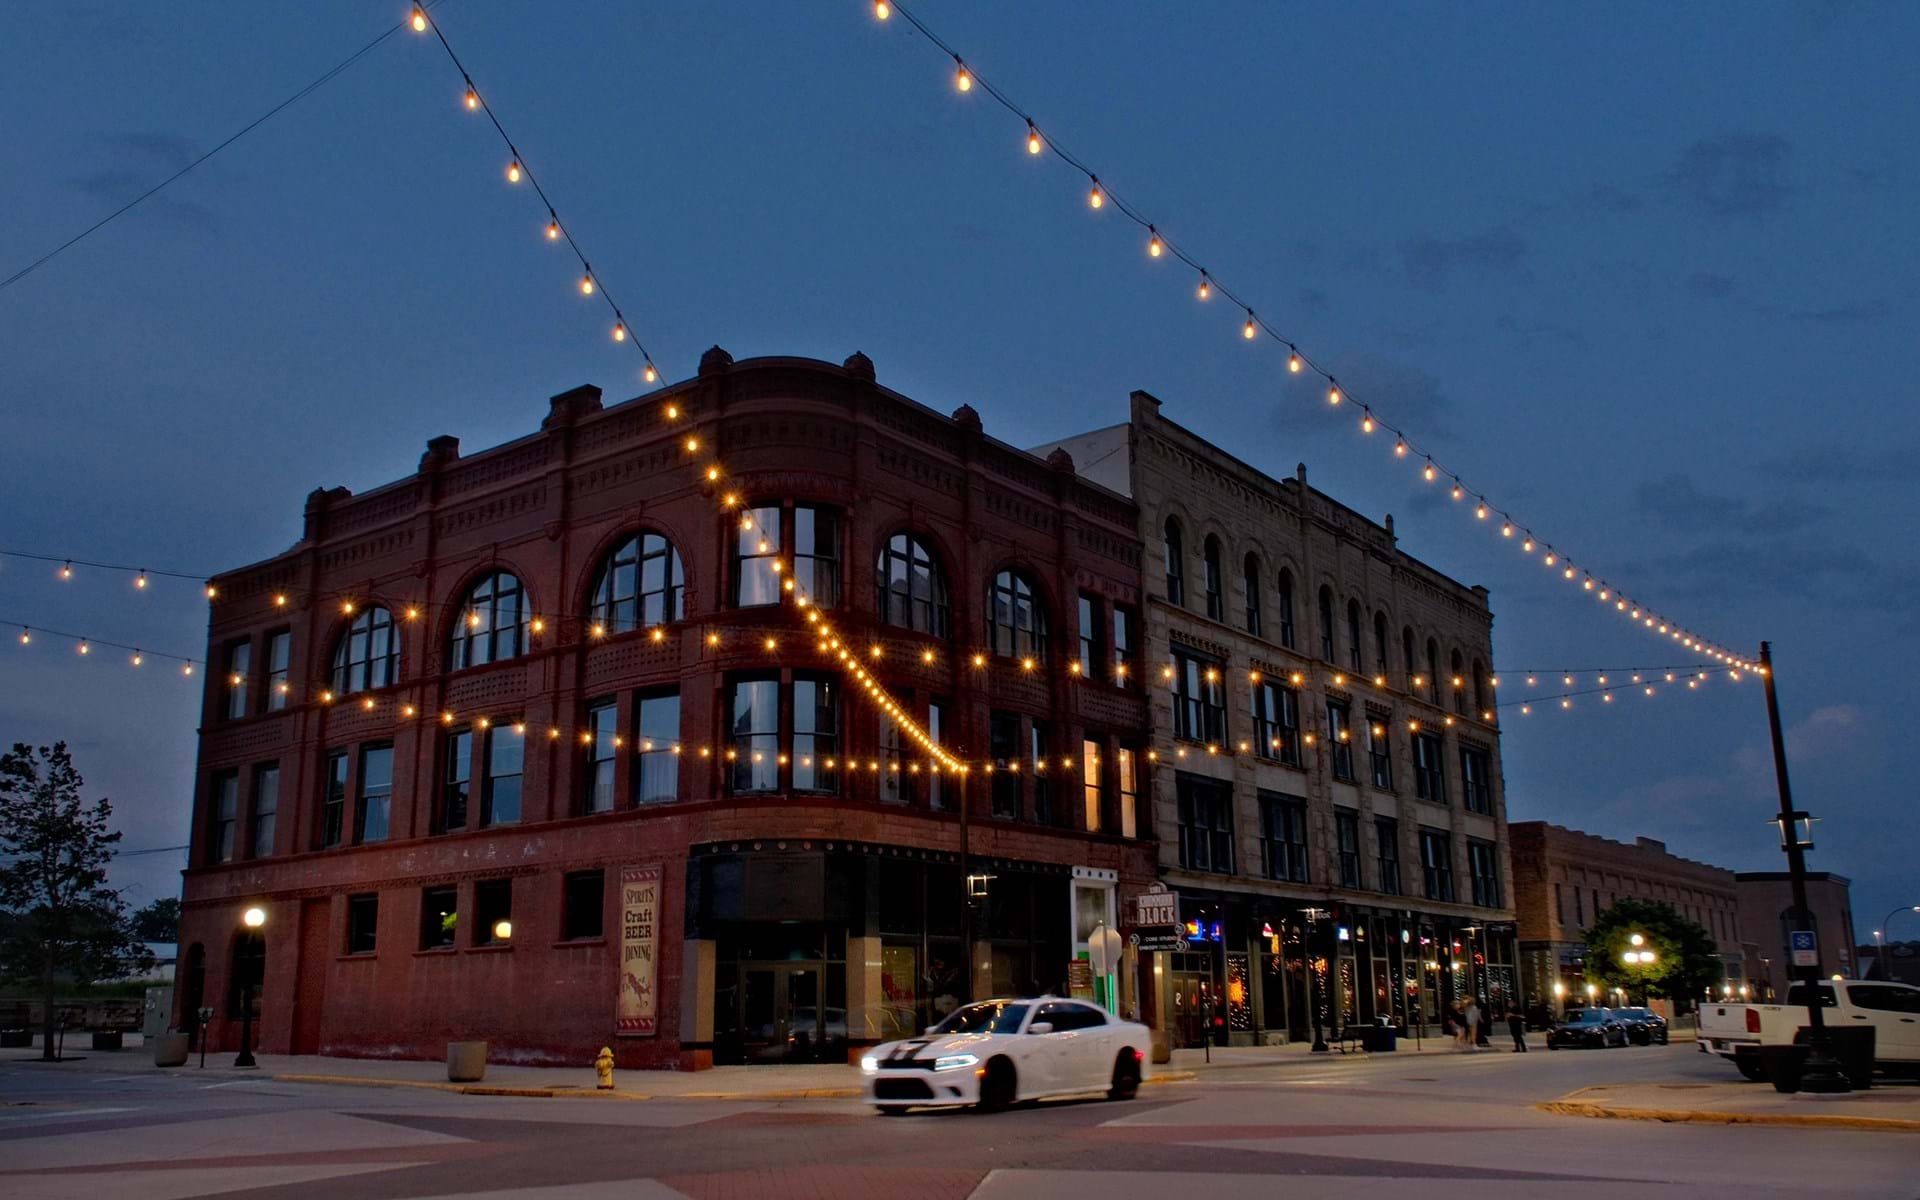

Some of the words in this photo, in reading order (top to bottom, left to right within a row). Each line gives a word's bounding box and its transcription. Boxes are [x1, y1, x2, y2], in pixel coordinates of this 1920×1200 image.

[626, 887, 654, 904] SPIRITS
[625, 909, 653, 923] Craft
[1139, 907, 1174, 924] BLOCK
[625, 925, 652, 939] BEER
[625, 944, 651, 961] DINING
